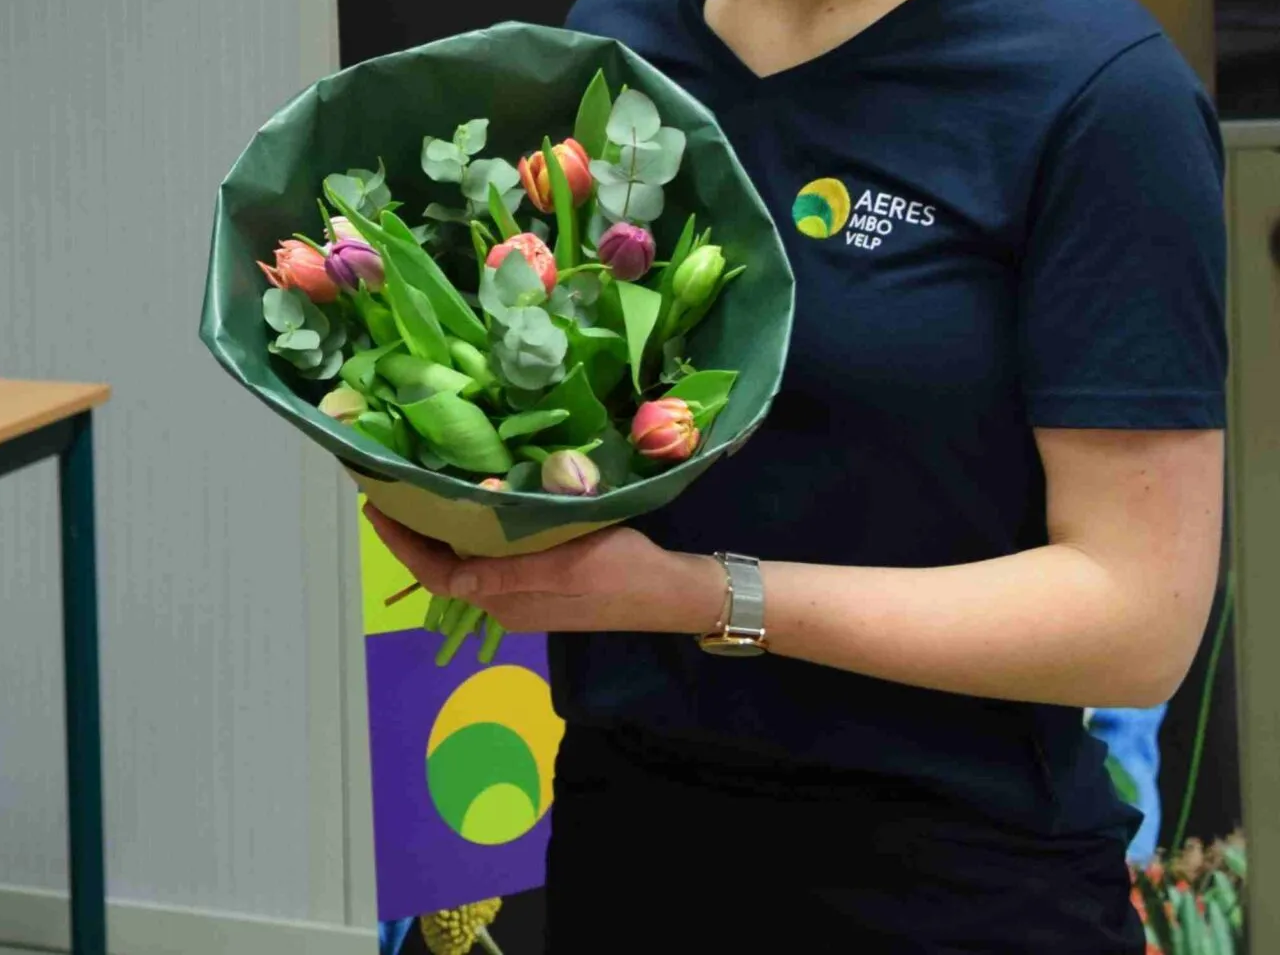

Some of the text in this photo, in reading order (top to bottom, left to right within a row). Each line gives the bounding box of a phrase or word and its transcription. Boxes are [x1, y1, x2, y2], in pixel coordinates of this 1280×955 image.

[854, 189, 936, 227] AERES
[849, 213, 893, 235] MBO
[845, 231, 882, 250] VELP
